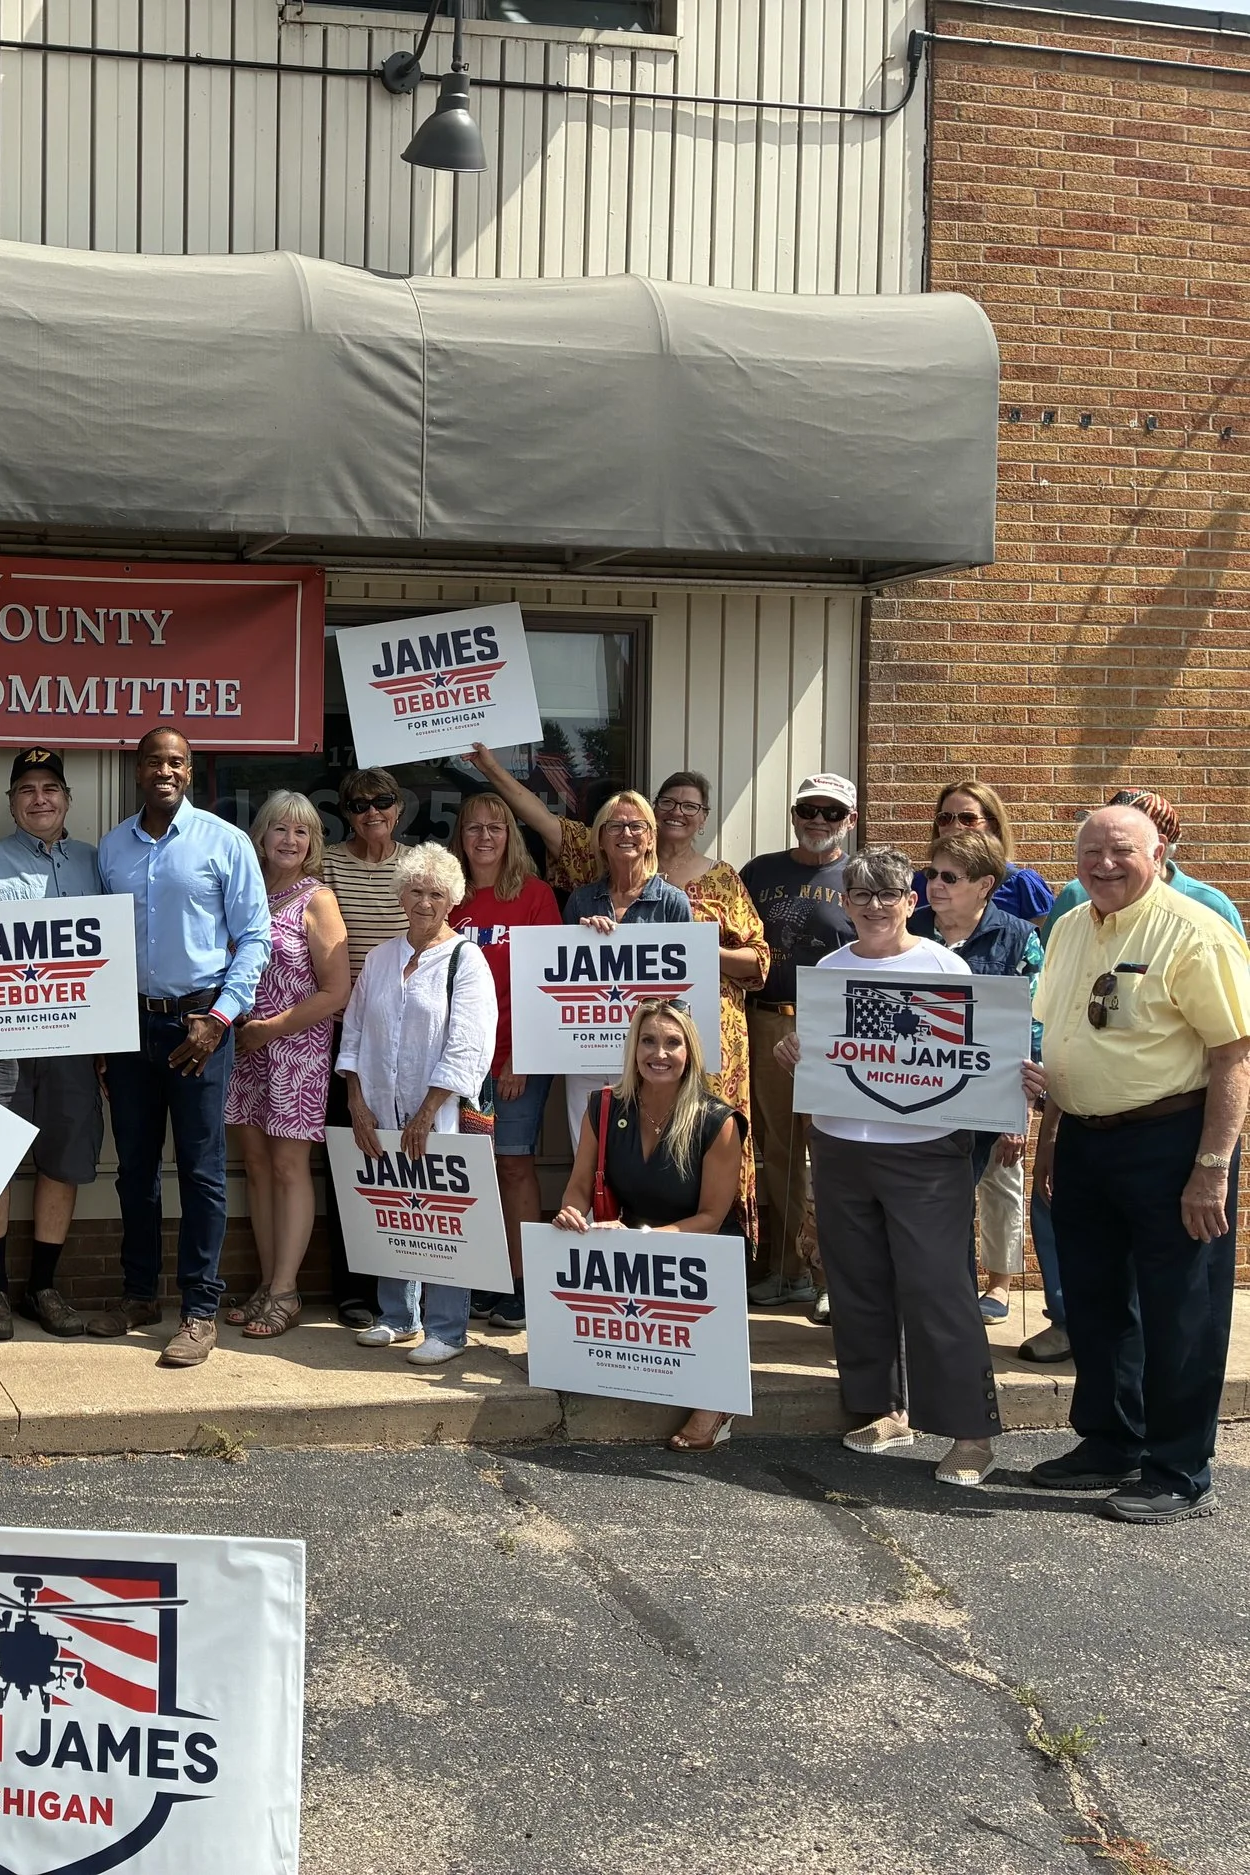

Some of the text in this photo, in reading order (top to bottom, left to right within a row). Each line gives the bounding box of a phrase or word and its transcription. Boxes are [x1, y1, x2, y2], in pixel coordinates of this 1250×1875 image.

[372, 625, 500, 678] JAMES
[393, 683, 492, 716] DEBOYER
[407, 711, 485, 731] FOR MICHIGAN
[24, 749, 51, 763] 47
[759, 885, 789, 903] U.S.
[544, 943, 687, 982] JAMES
[16, 1012, 77, 1024] MICHIGAN
[561, 1004, 639, 1024] DEBOY
[573, 1033, 595, 1041] FOR
[825, 1041, 991, 1071] JOHN JAMES
[866, 1071, 943, 1088] MICHIGAN
[356, 1151, 471, 1194] JAMES
[375, 1208, 464, 1237] DEBOYER
[388, 1238, 457, 1253] FOR MICHIGAN
[556, 1248, 708, 1301] JAMES
[575, 1315, 692, 1349] DEBOYER
[588, 1348, 681, 1367] FOR MICHIGAN
[596, 1361, 626, 1369] GOVERNOR
[642, 1367, 674, 1375] GOVERNOR
[15, 1718, 219, 1784] JAMES
